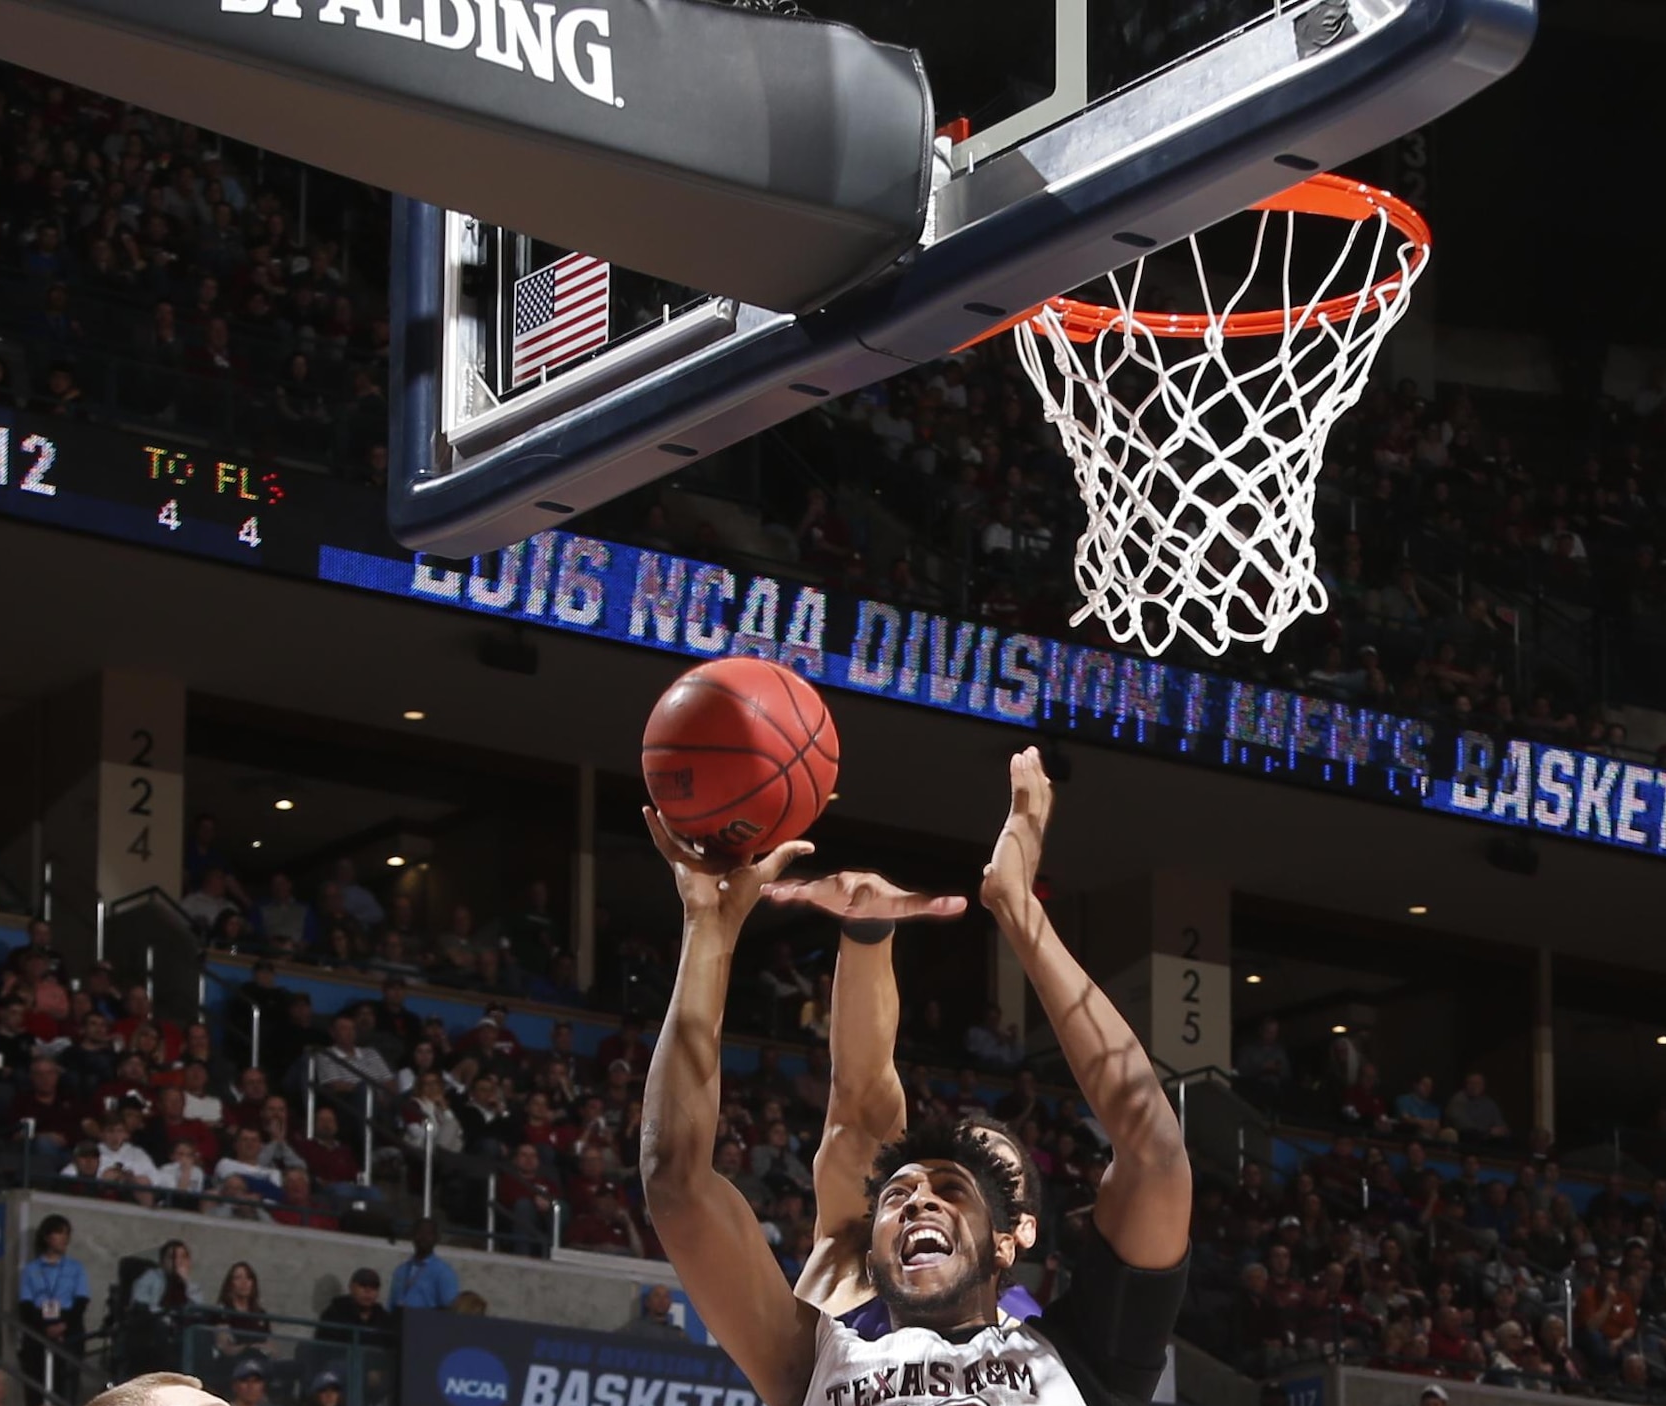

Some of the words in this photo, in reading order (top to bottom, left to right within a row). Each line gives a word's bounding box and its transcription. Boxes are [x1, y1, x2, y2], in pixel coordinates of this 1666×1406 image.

[219, 0, 617, 107] LDING
[157, 498, 183, 532] 4
[237, 515, 263, 548] 4
[628, 548, 827, 668] NCAA
[127, 729, 154, 862] 224
[1181, 927, 1201, 1044] 225
[444, 1376, 509, 1400] NCAA
[963, 1358, 1040, 1398] A&M
